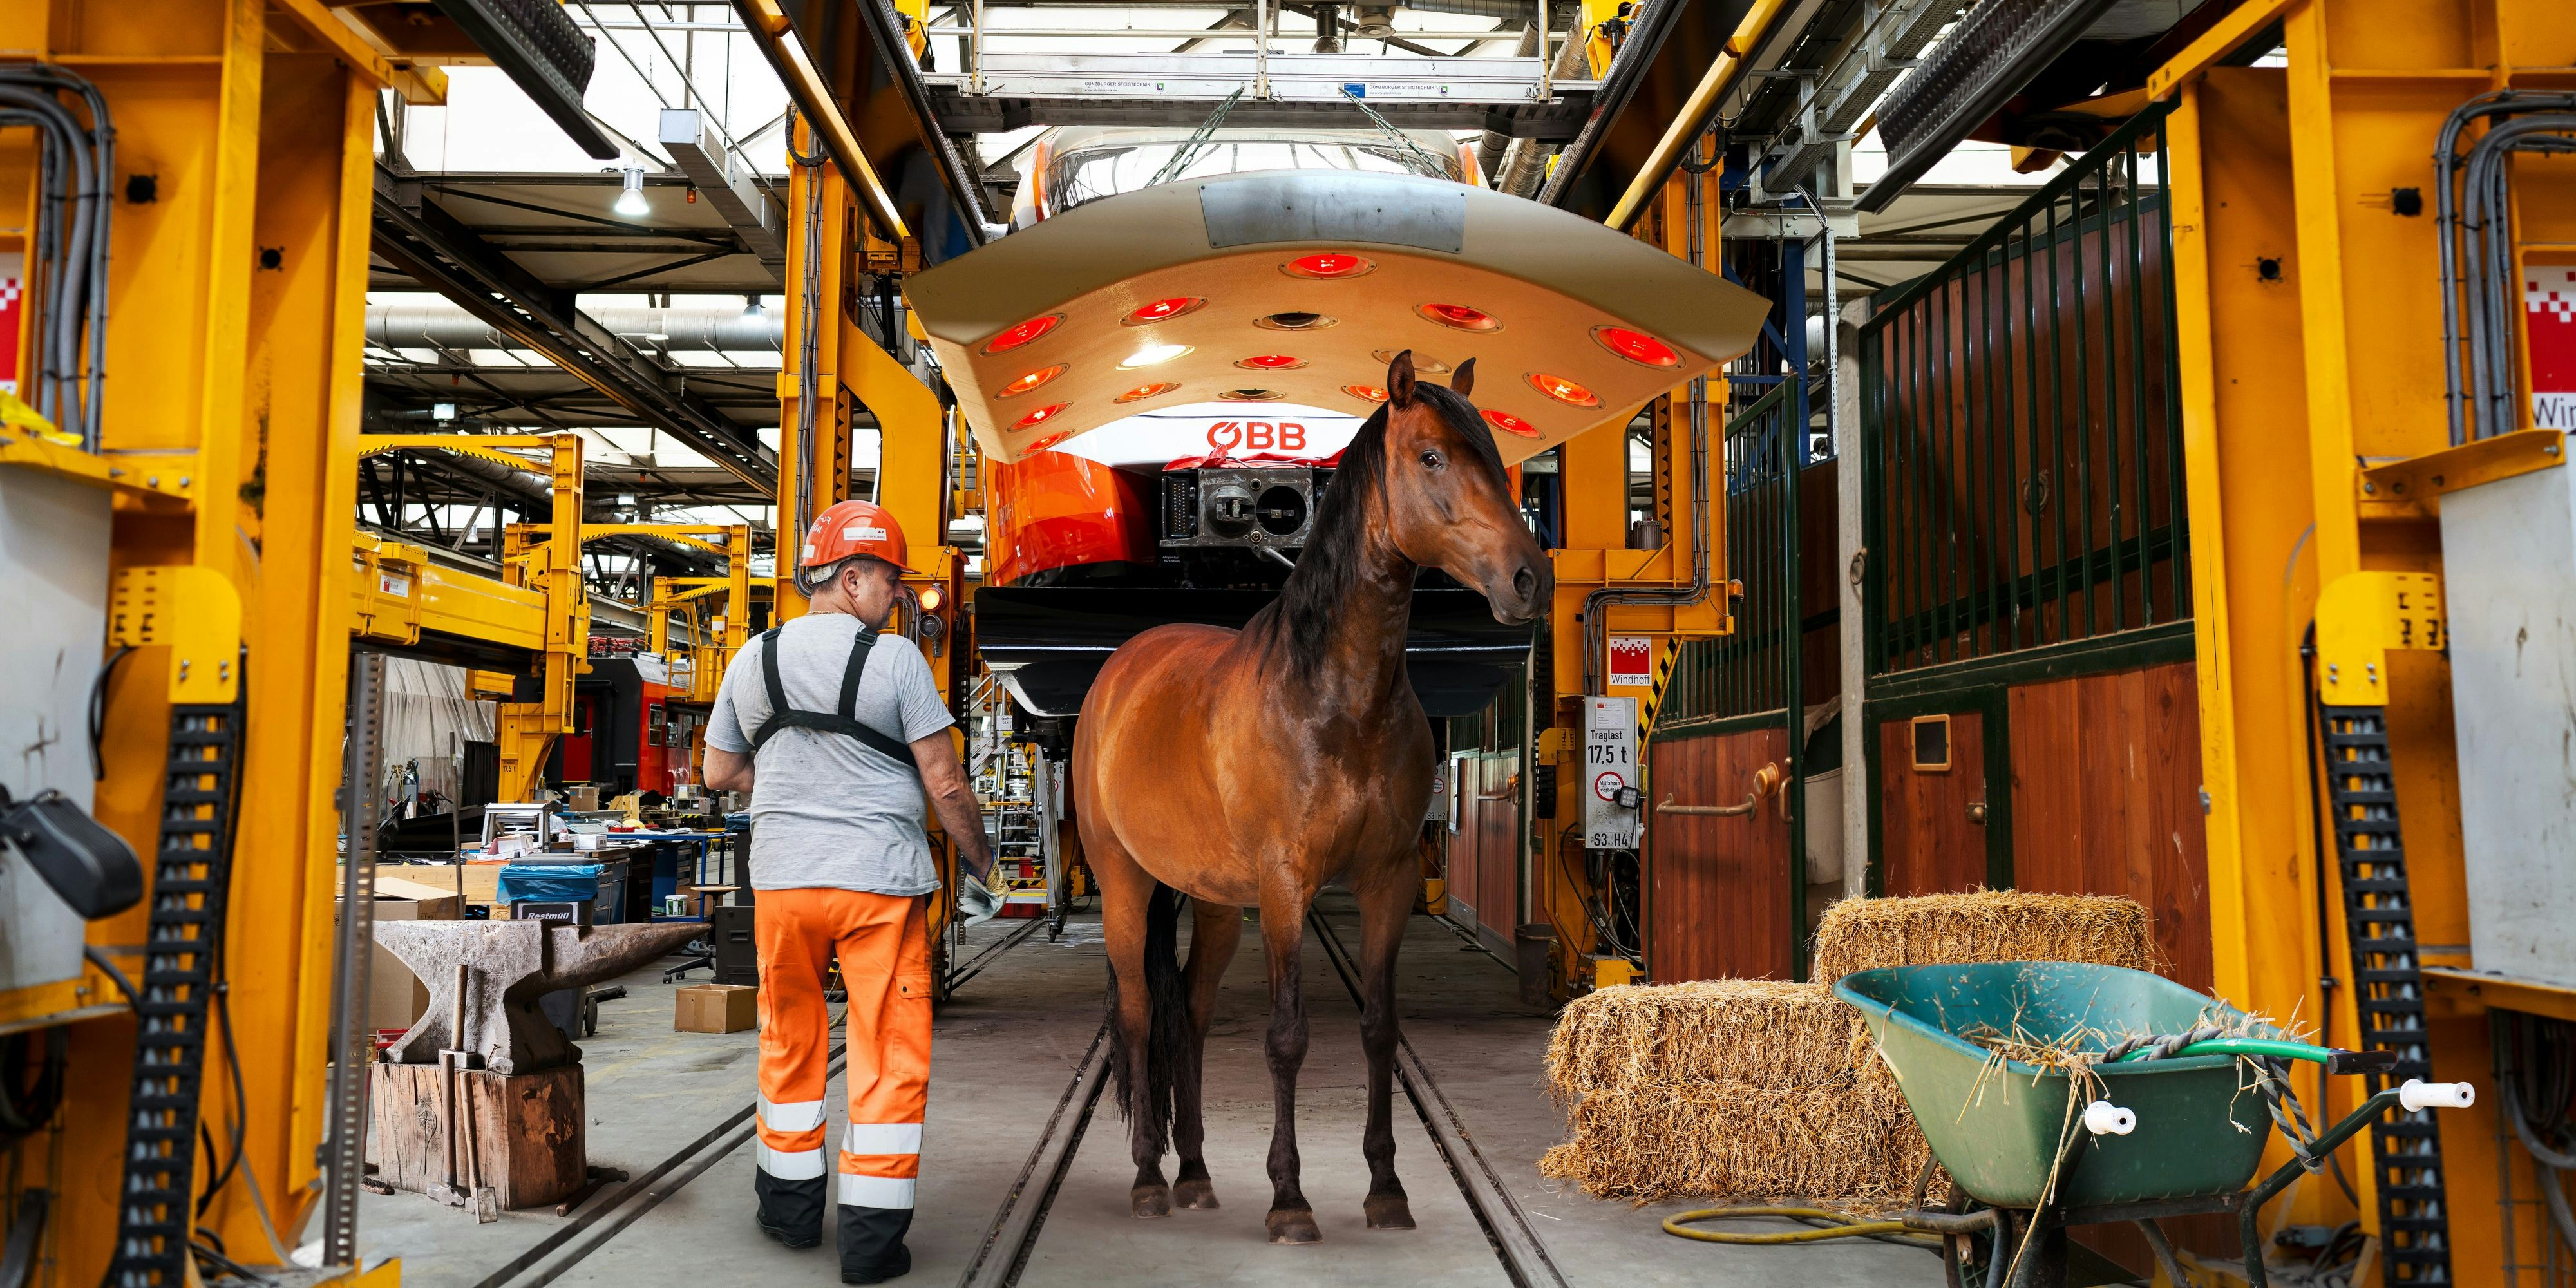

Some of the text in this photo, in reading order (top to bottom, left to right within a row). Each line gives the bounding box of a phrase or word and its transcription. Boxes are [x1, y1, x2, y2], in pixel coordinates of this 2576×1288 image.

[1611, 674, 1650, 685] Windhoff
[1591, 730, 1622, 742] Traglast
[1587, 745, 1627, 765] 17,5 t
[1594, 833, 1628, 846] S3 H4
